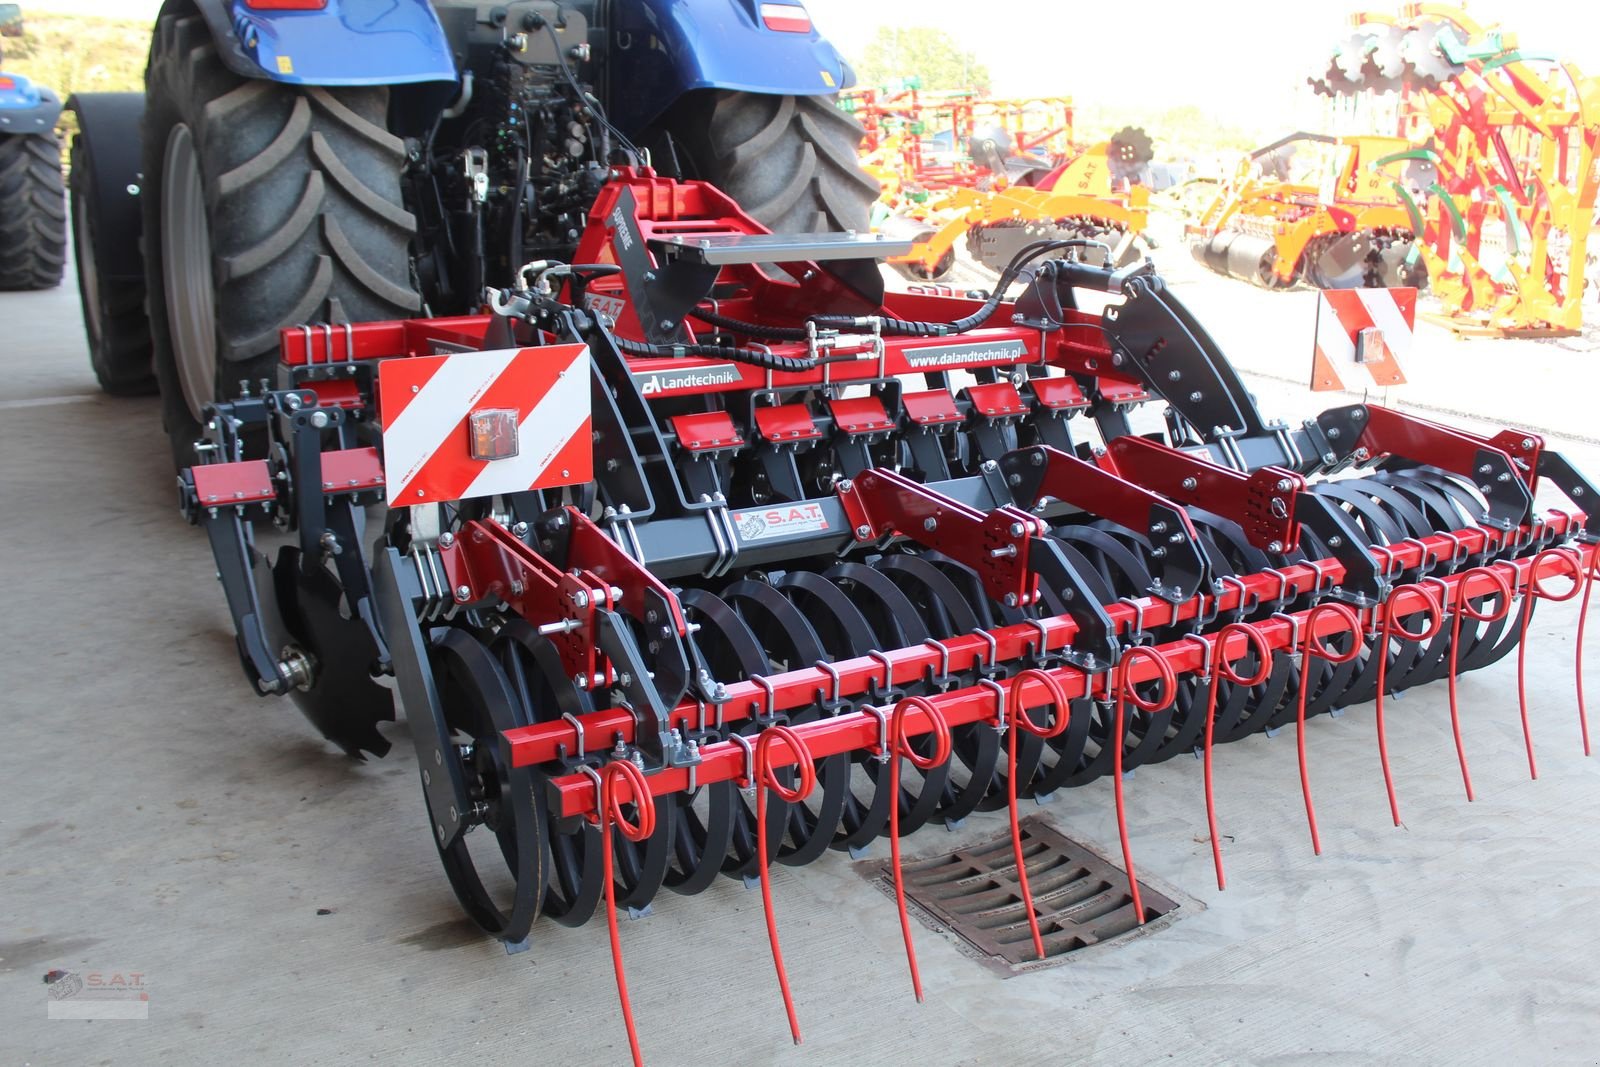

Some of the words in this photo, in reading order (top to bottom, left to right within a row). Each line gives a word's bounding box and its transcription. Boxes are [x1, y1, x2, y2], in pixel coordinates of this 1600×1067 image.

[612, 206, 633, 251] SUPREME
[910, 347, 1021, 368] www.dalandtechnik.pl
[662, 371, 734, 390] Landtechnik
[765, 505, 822, 525] S.A.T.
